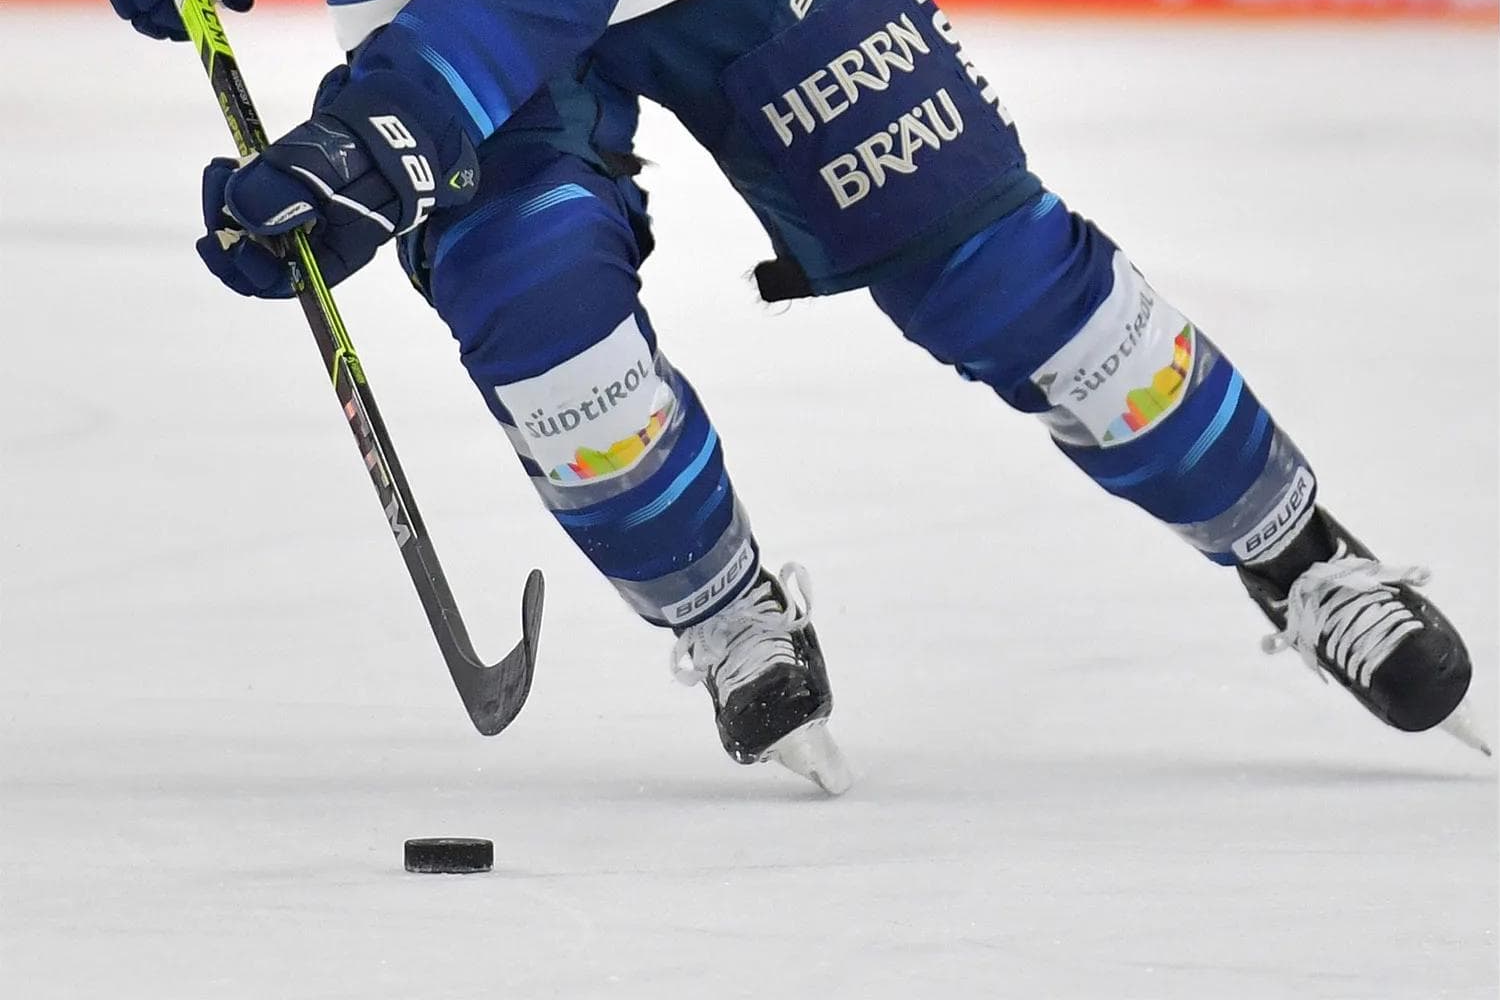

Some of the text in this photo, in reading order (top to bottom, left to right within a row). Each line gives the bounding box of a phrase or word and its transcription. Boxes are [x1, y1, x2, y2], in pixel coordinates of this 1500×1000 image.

[760, 13, 931, 148] HERRN
[368, 114, 437, 237] BAU
[818, 88, 964, 210] BRÄU
[1244, 475, 1309, 554] BAUER
[673, 548, 752, 618] BAUER
